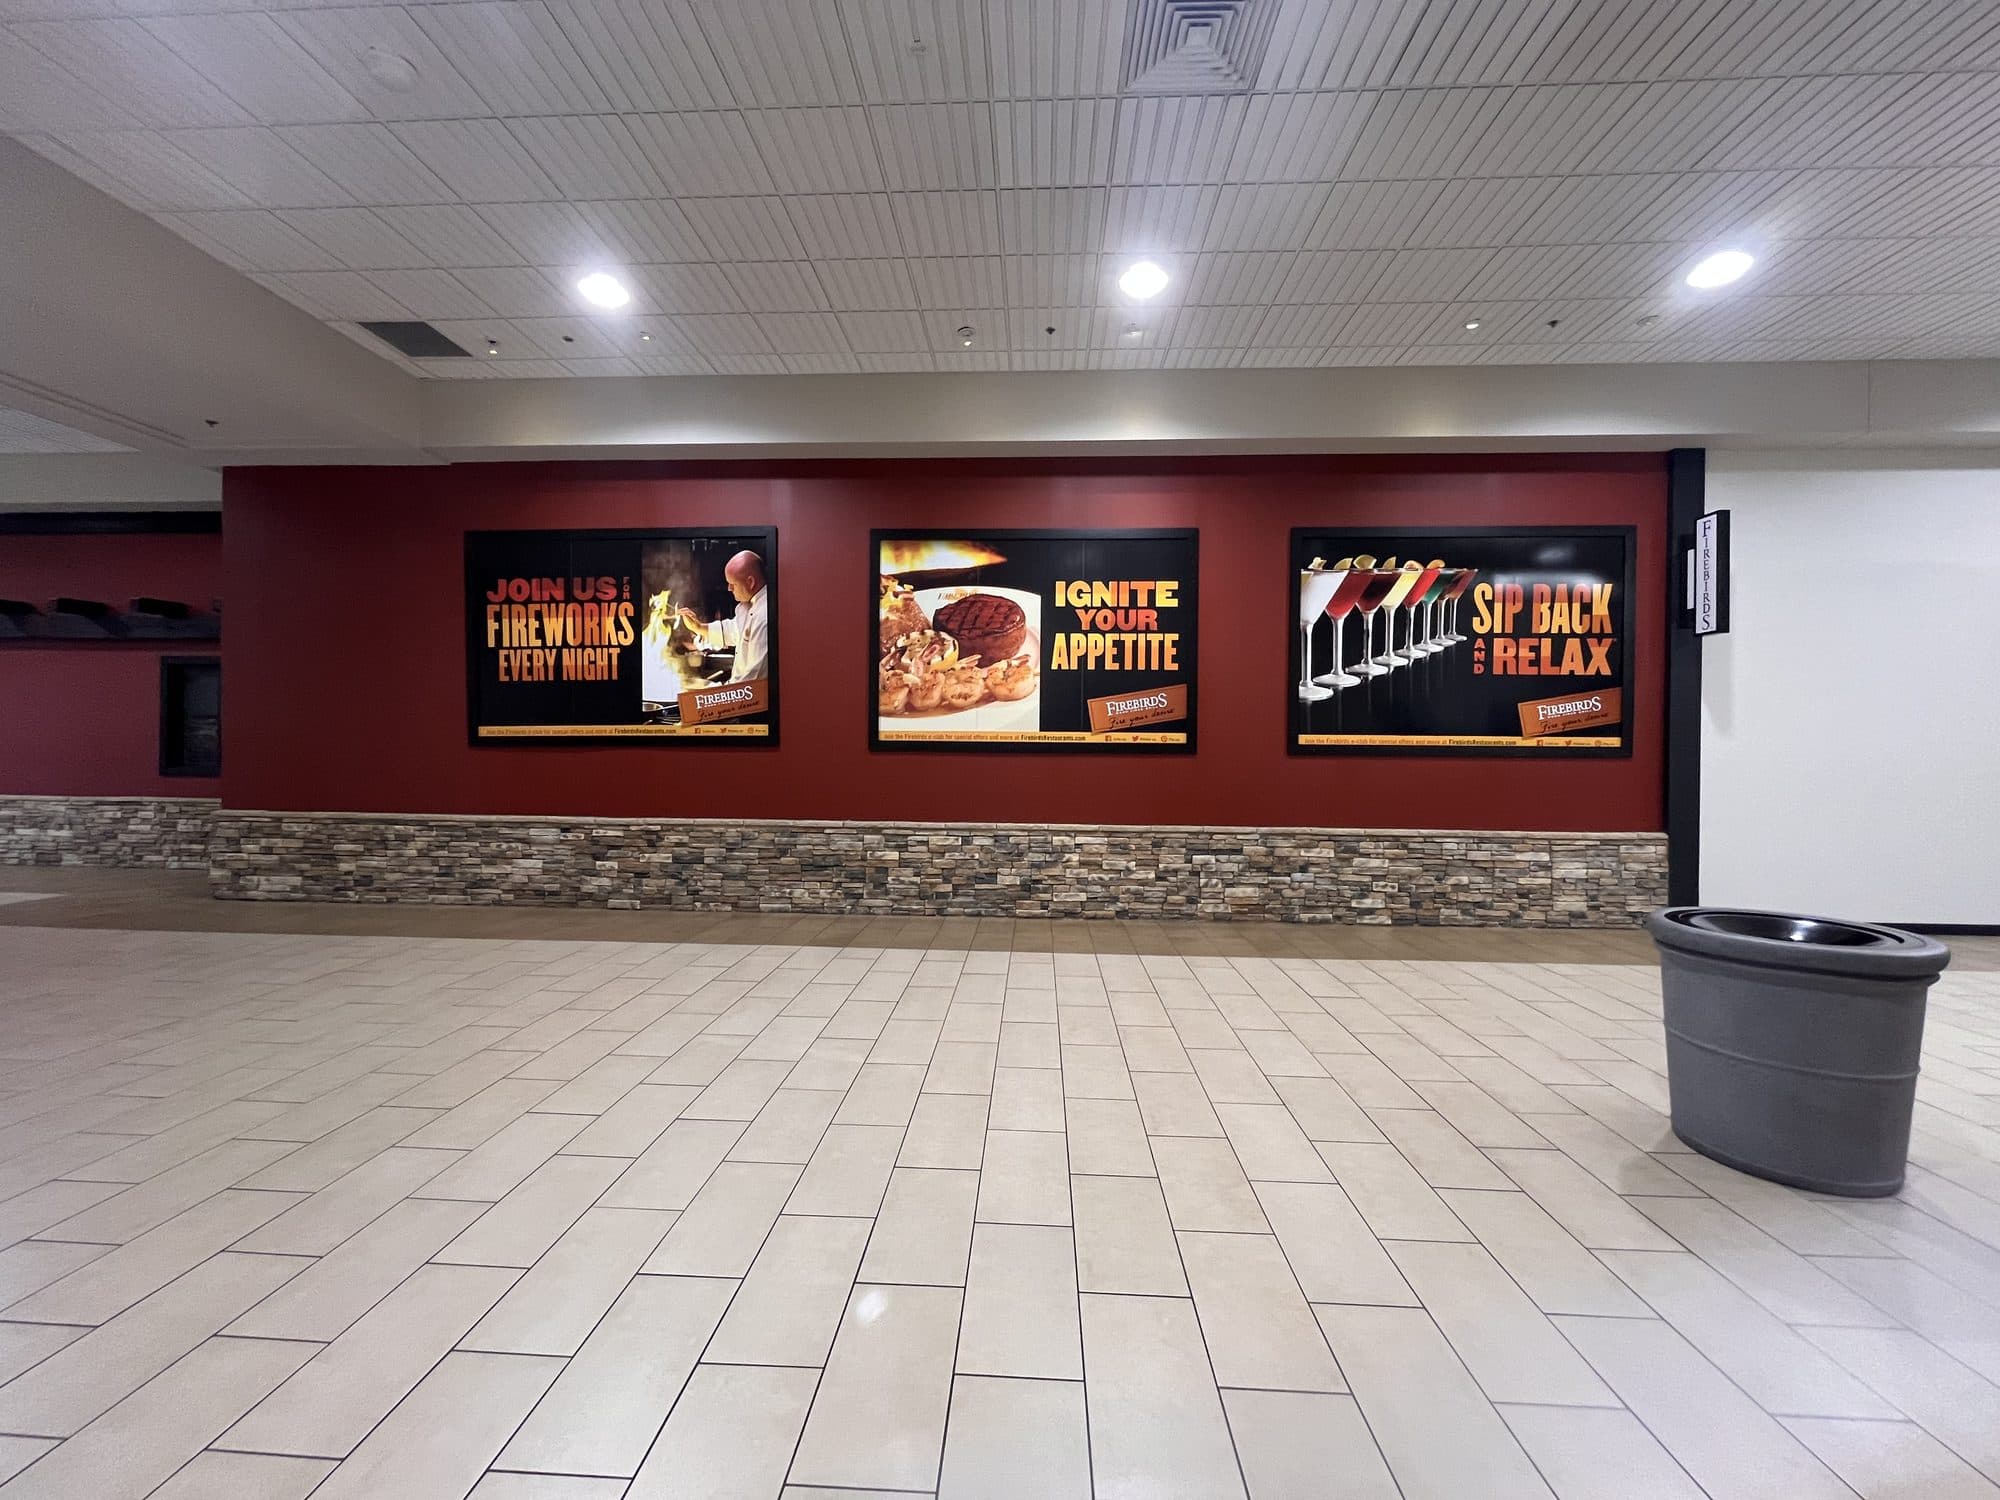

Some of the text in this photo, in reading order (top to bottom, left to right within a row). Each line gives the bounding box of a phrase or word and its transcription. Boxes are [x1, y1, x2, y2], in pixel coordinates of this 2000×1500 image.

[486, 576, 617, 602] JOIN US
[1702, 519, 1711, 631] FIREBIRDS
[1055, 580, 1179, 608] IGNITE
[1472, 582, 1613, 634] SIP BACK
[486, 601, 635, 648] FIREWORKS
[1075, 608, 1158, 631] YOUR
[499, 647, 621, 682] EVERY NIGHT
[1051, 633, 1179, 671] APPETITE
[1473, 638, 1485, 674] AND
[1492, 637, 1613, 676] RELAX
[695, 686, 753, 709] FIREBIRDS
[1106, 693, 1167, 717] FIREBIRDS
[1537, 696, 1601, 721] FIREBIRDS
